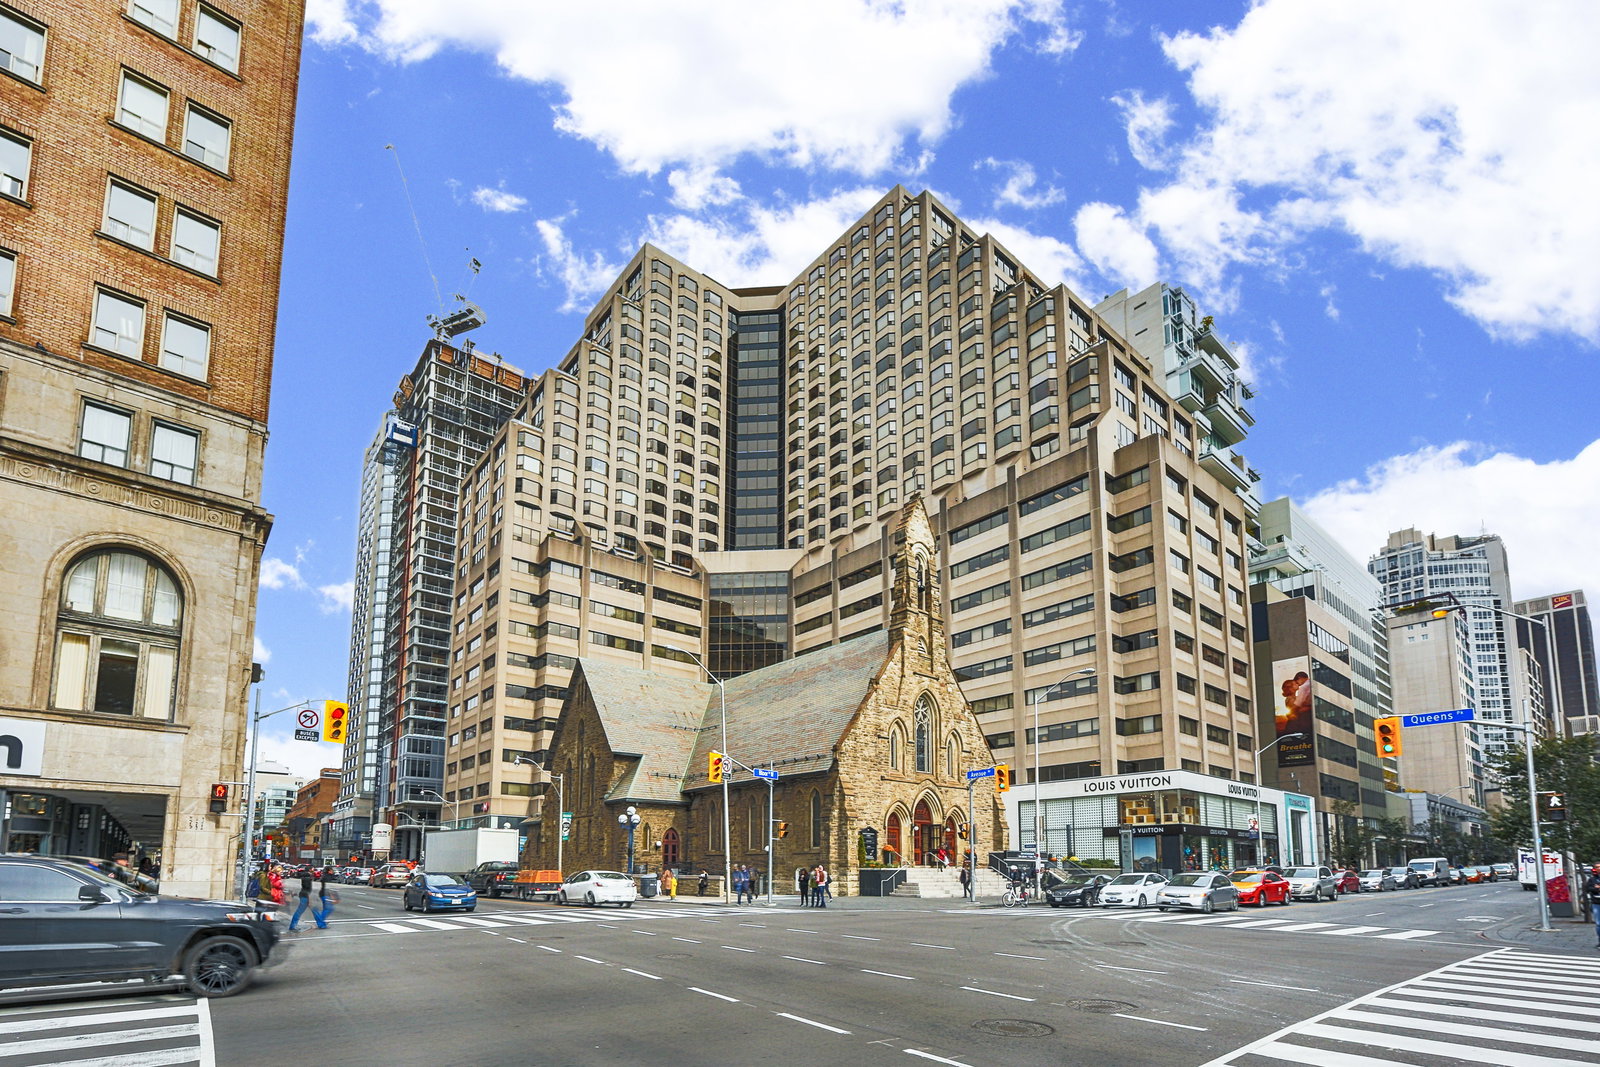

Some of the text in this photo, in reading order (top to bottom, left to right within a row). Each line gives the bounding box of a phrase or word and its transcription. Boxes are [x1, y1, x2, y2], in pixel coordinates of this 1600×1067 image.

[1411, 713, 1453, 724] Queens
[1280, 743, 1312, 751] Breathe
[1084, 775, 1171, 793] LOUIS VUITTON
[1227, 783, 1242, 796] LOUIS
[1521, 854, 1559, 864] FeEx
